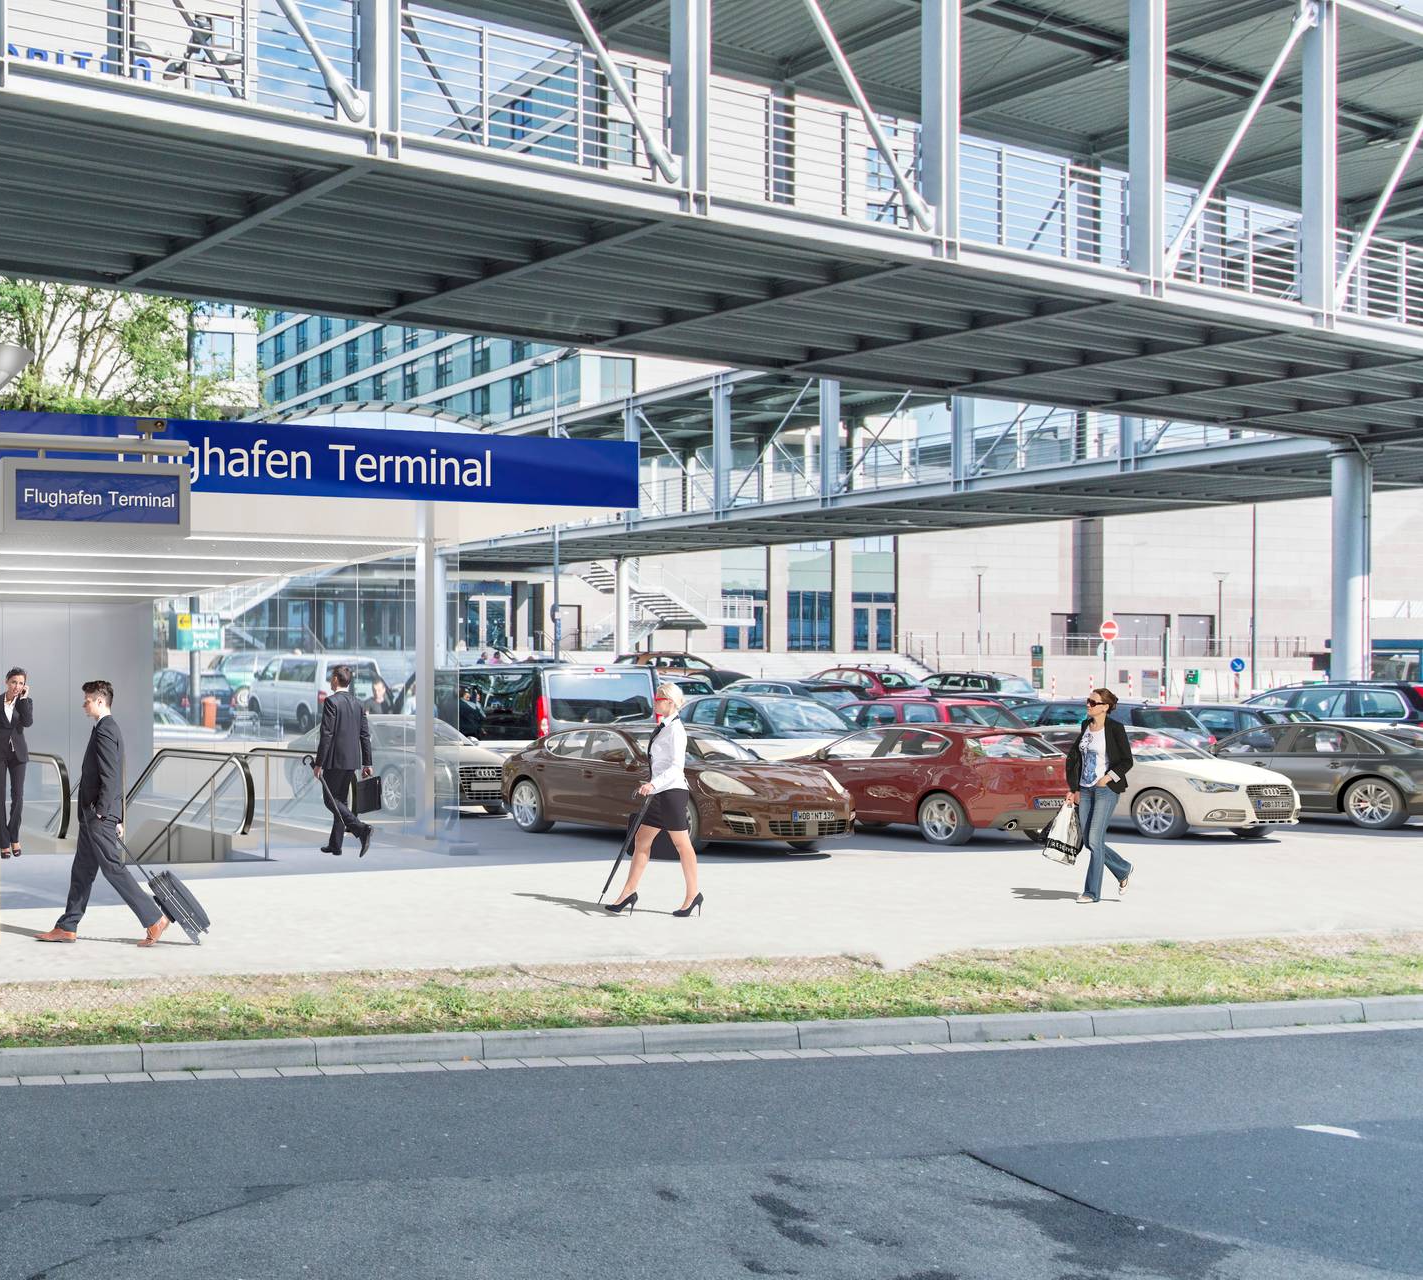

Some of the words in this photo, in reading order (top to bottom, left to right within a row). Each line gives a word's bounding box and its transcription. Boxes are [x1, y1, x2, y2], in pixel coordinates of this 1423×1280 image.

[118, 434, 312, 485] ghafen
[329, 444, 491, 487] Terminal
[24, 488, 102, 507] Flughafen
[108, 491, 175, 508] Terminal
